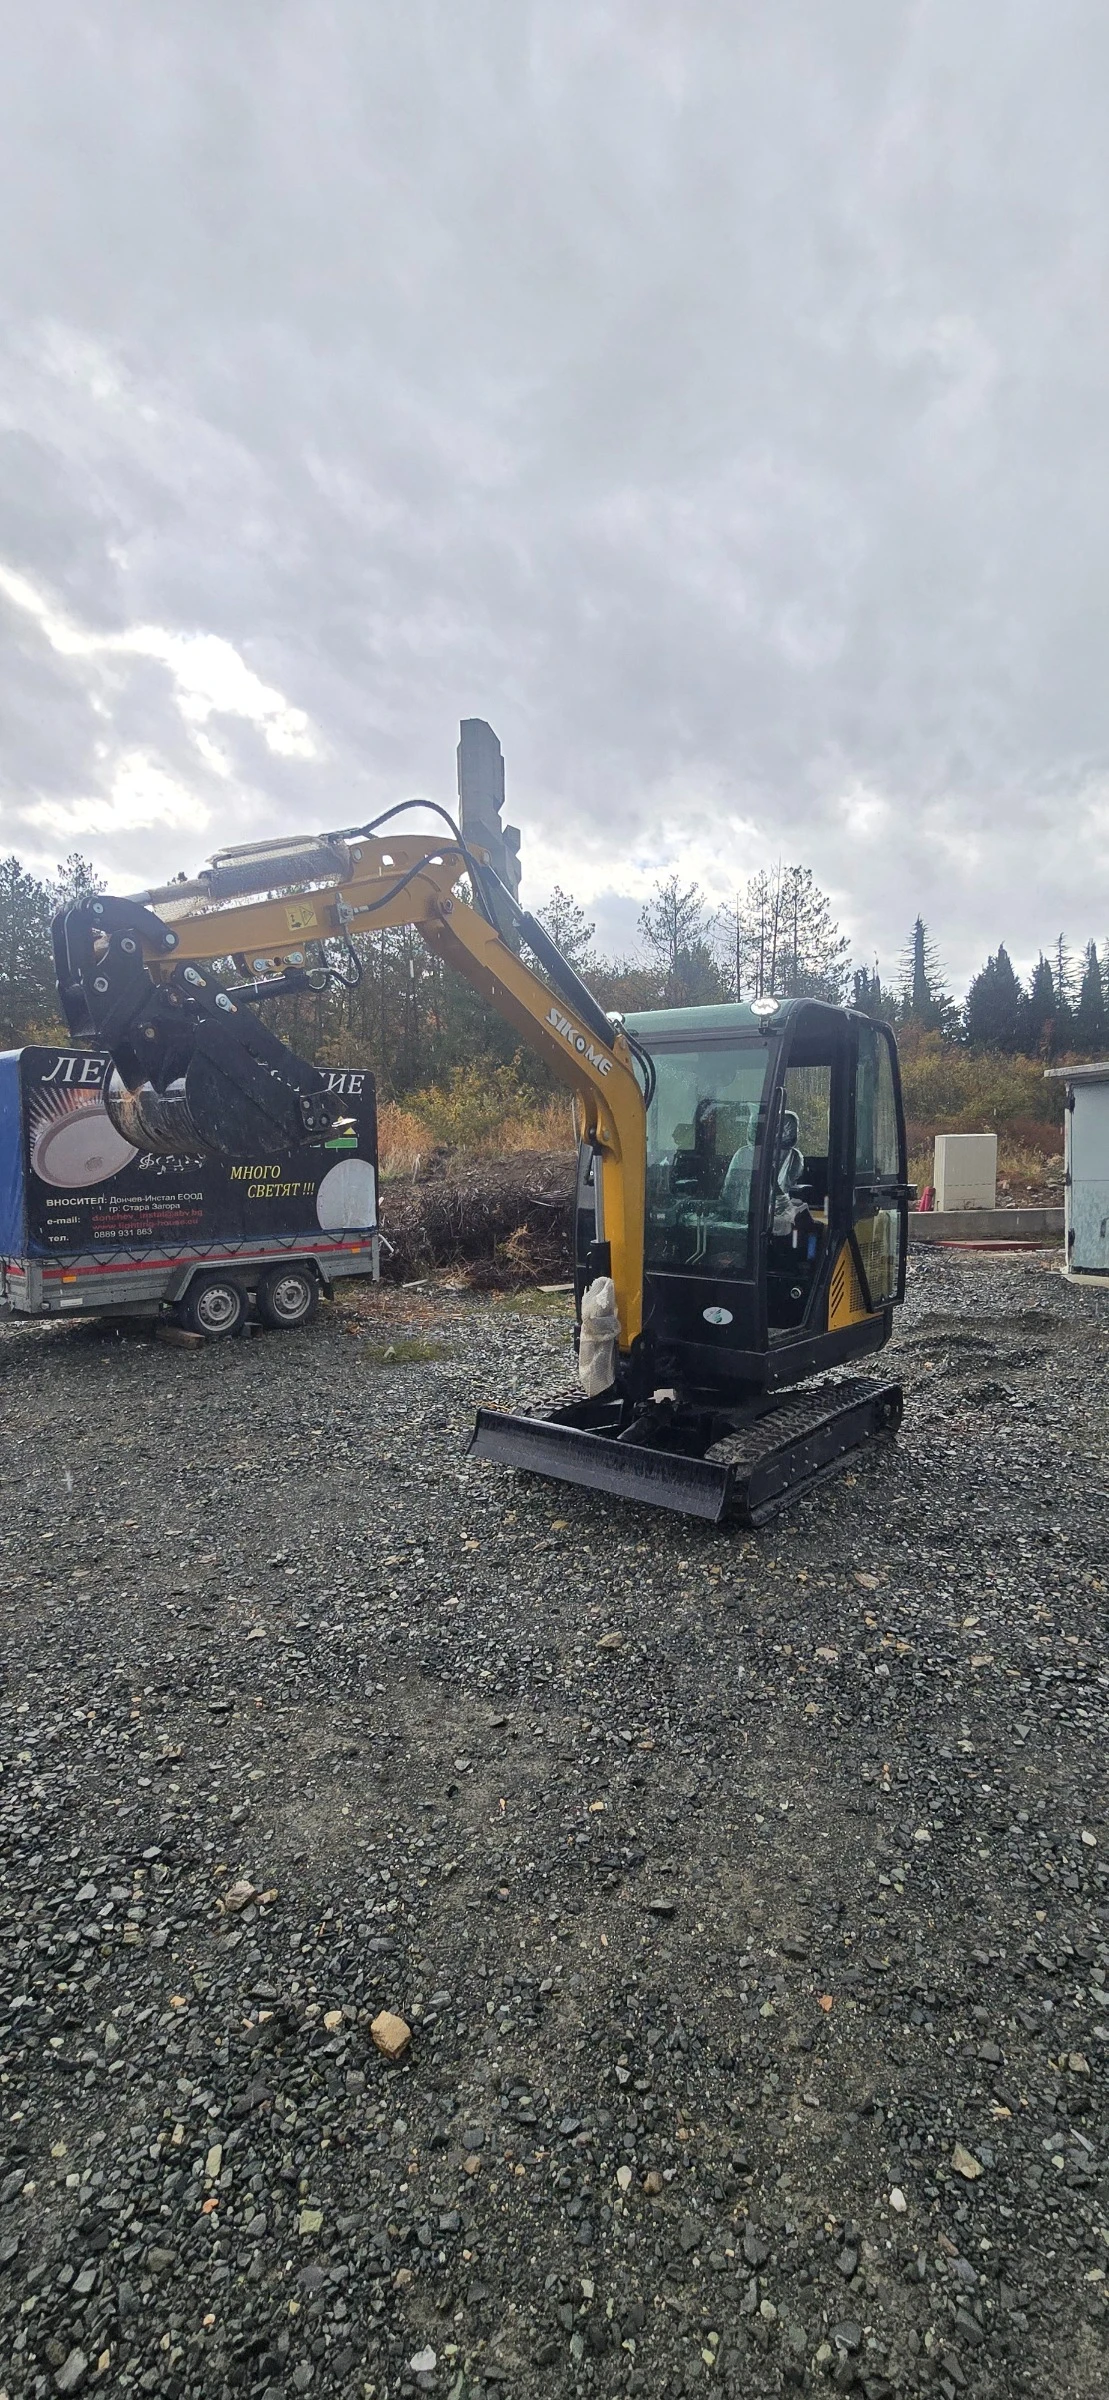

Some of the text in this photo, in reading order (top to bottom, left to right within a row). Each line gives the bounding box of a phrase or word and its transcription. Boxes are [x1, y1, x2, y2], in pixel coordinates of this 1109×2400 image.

[545, 1008, 613, 1076] SIKOME
[41, 1056, 365, 1094] ЛЕ ИЕ
[230, 1165, 281, 1180] МНОГО
[247, 1182, 315, 1198] СВЕТЯТ !!!
[46, 1193, 203, 1207] ВНОСИТЕЛ: Дончев-Инстал ЕООД
[122, 1204, 150, 1212] Стара
[151, 1203, 181, 1211] Загора
[47, 1216, 81, 1225] e-mail:
[94, 1231, 116, 1239] 0889
[118, 1229, 134, 1237] 931
